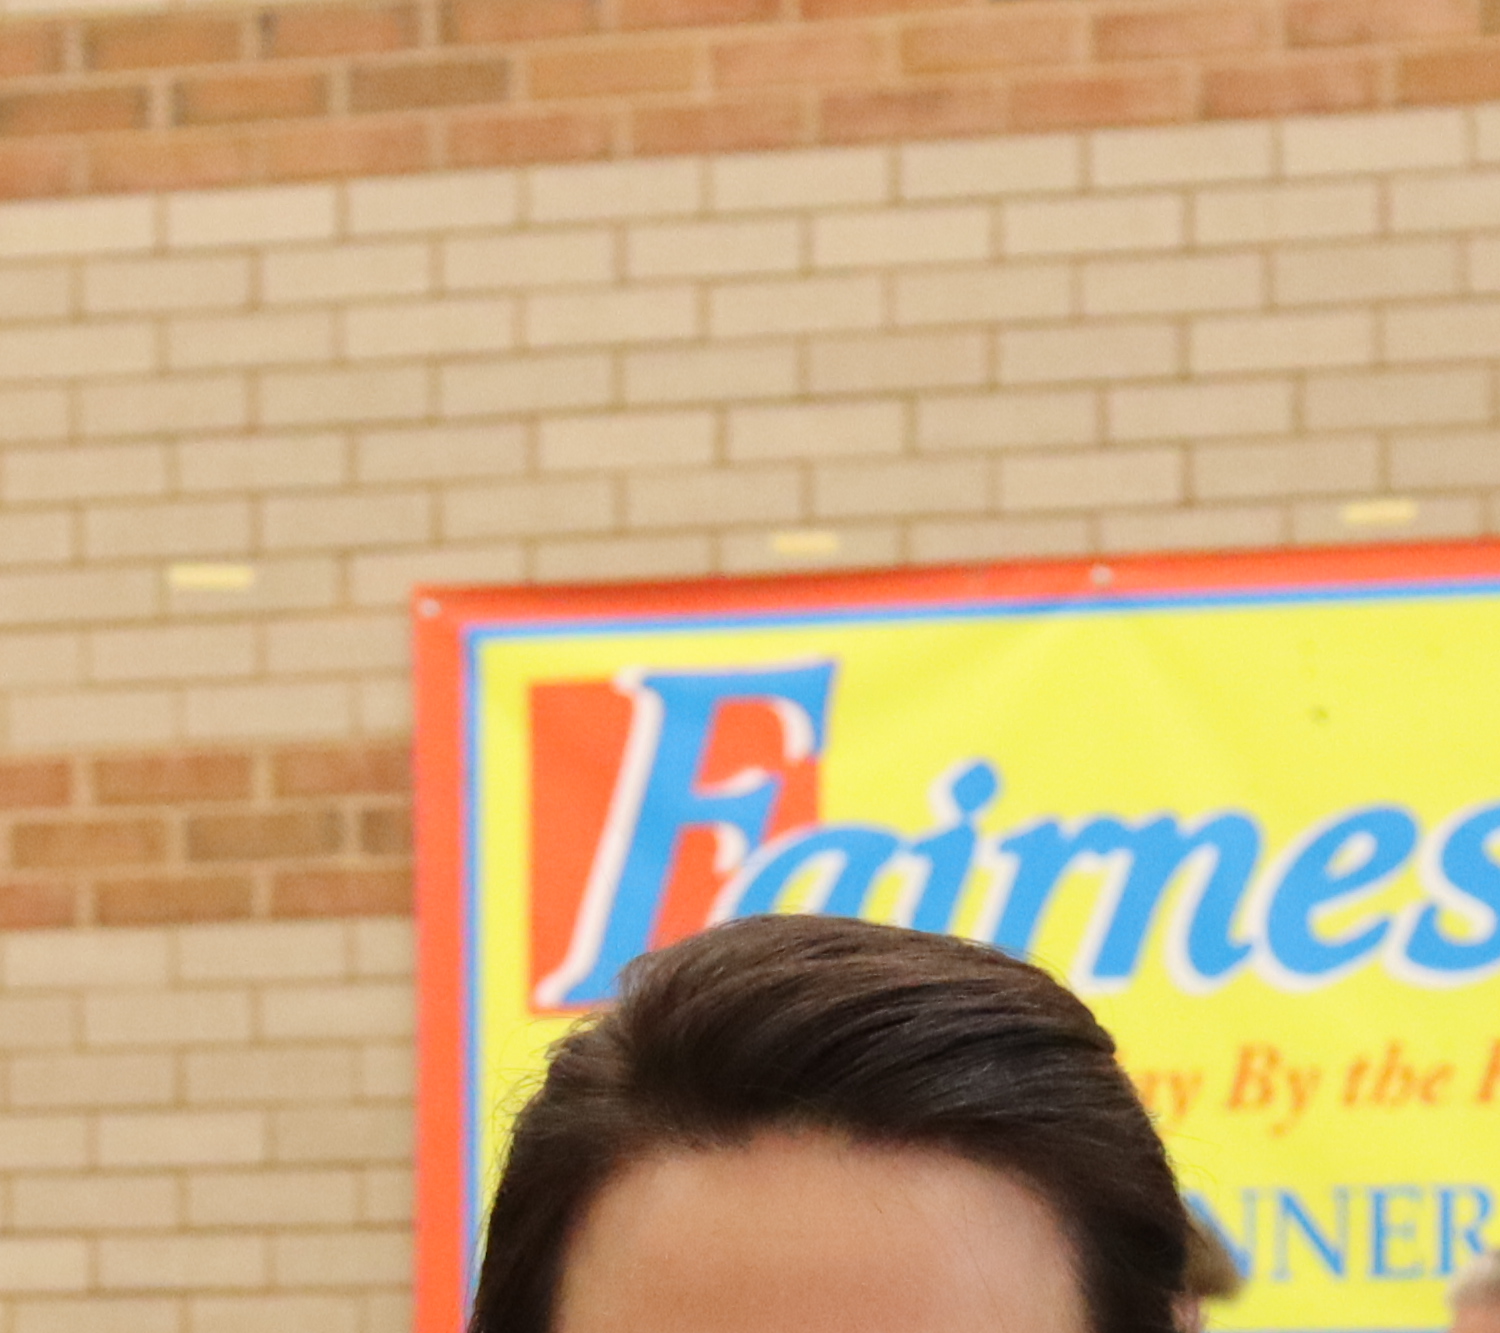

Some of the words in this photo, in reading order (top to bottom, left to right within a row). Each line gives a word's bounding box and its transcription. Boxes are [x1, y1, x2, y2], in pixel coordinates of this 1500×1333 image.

[1226, 1041, 1322, 1136] By
[1342, 1040, 1455, 1107] the
[1181, 1183, 1495, 1280] NNER
